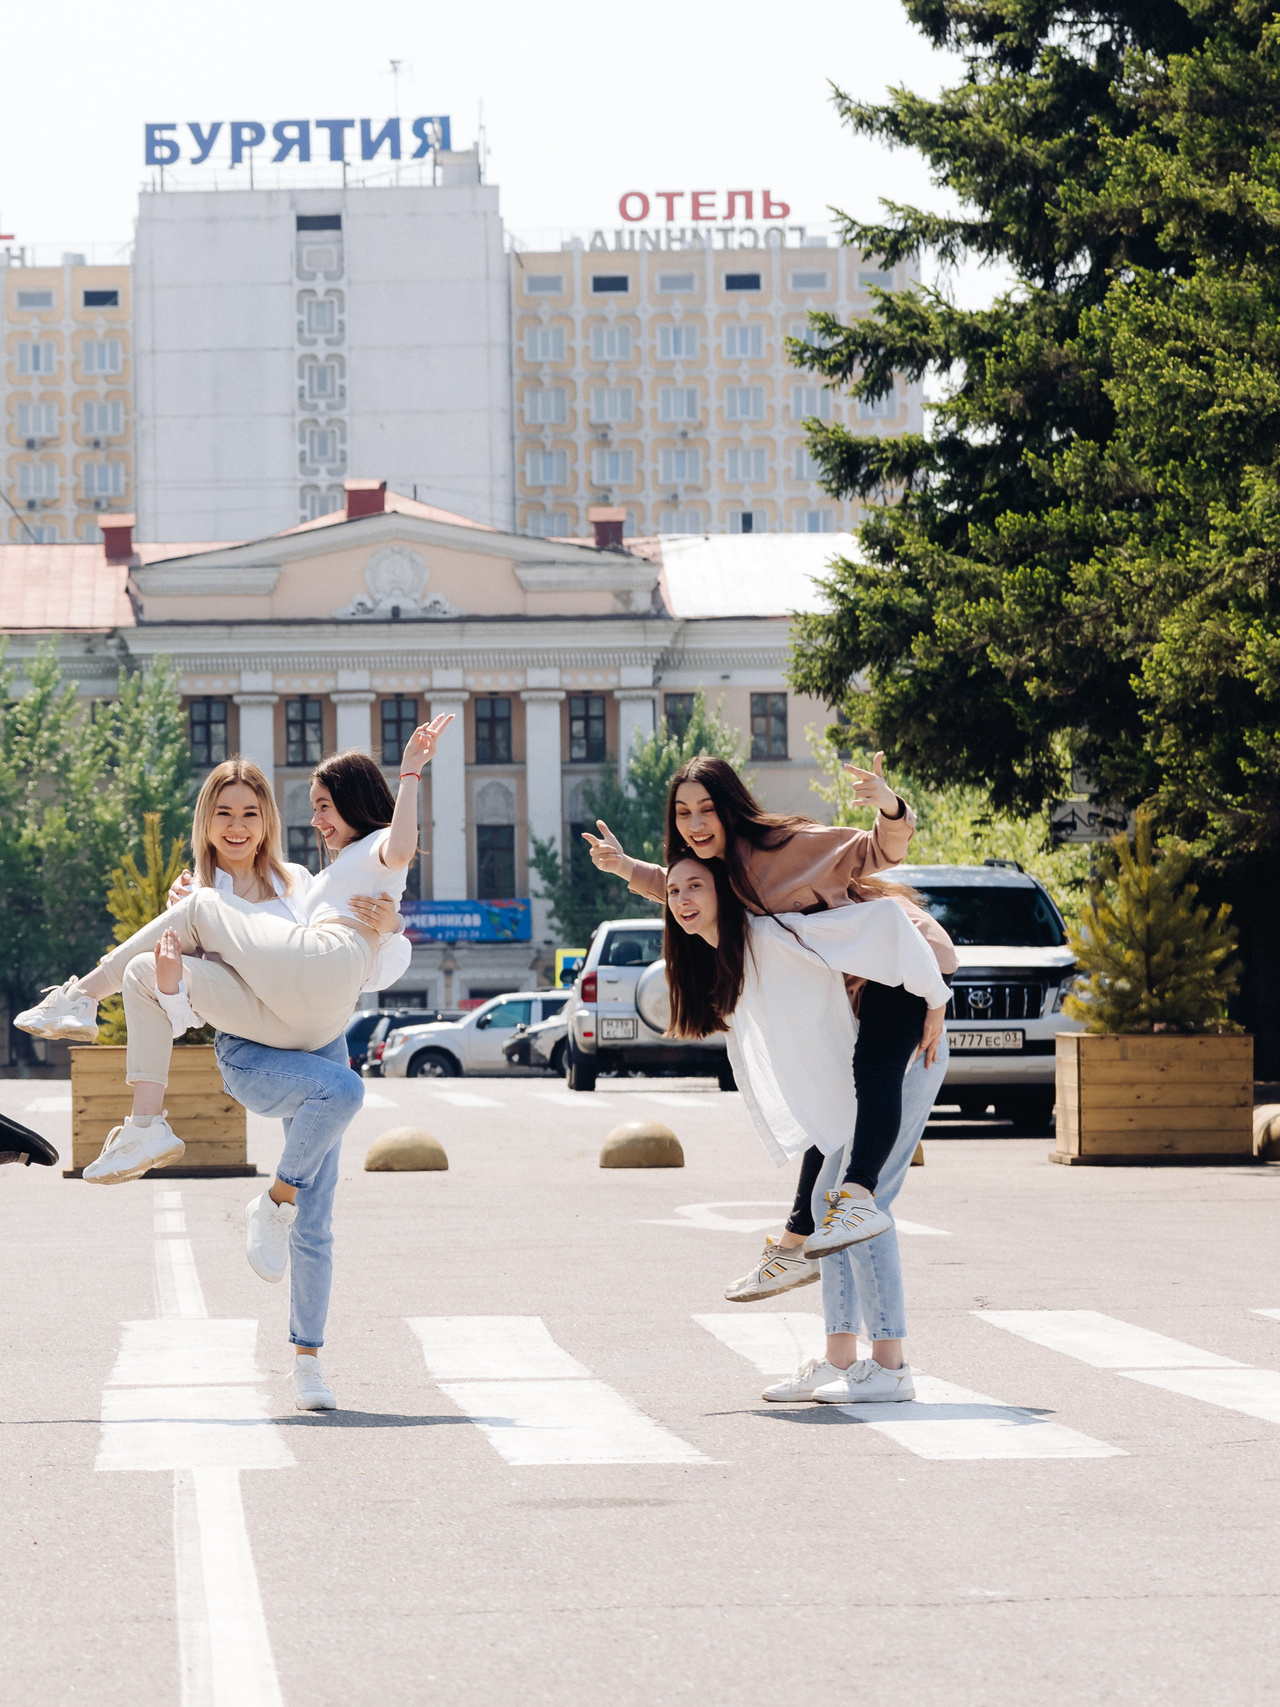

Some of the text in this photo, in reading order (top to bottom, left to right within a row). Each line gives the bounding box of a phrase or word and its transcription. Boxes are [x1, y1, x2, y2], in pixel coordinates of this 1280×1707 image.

[144, 116, 452, 166] БУРЯТИЯ
[619, 190, 791, 222] ОТЕЛЬ
[404, 913, 482, 928] ОЧЕВНИКОВ
